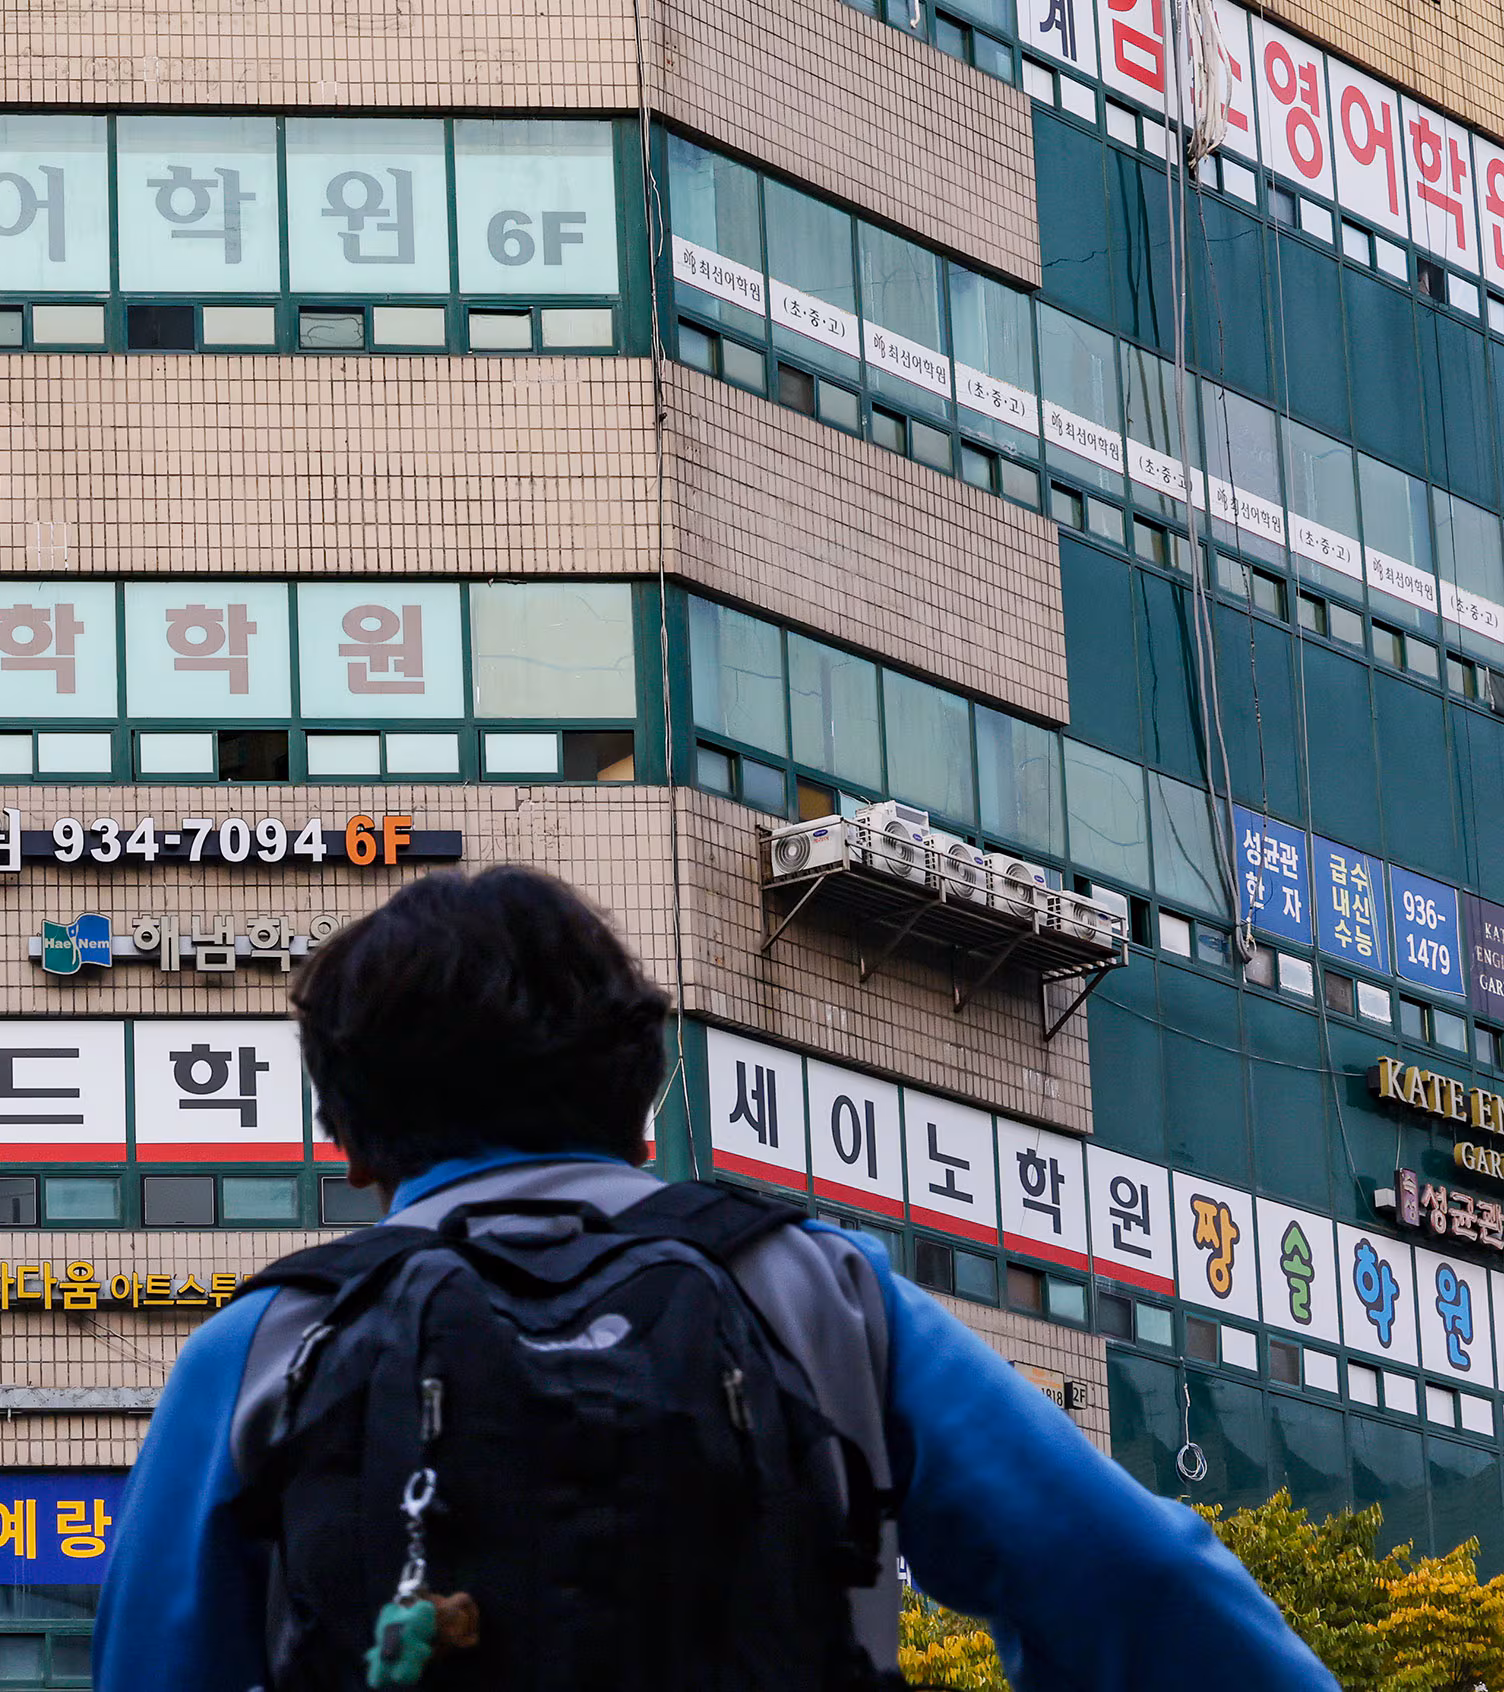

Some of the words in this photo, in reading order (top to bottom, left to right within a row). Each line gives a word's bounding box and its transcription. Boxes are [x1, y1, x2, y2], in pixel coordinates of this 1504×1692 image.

[487, 210, 587, 265] 6F
[699, 259, 761, 302] 최선어학원
[888, 342, 947, 385] 최선어학원
[1065, 420, 1120, 461] 최선어학원
[1229, 493, 1282, 534] 최선어학원
[1386, 567, 1434, 601] 최선어학원
[52, 817, 327, 863] 934-7094
[345, 815, 413, 866] 6F
[1243, 829, 1299, 880] 성균관
[1330, 854, 1368, 892] 급수
[1332, 886, 1371, 925] 내신
[1403, 890, 1446, 930] 936-
[1334, 919, 1373, 957] 수능
[1406, 934, 1451, 976] 1479
[1377, 1056, 1467, 1122] KATE
[729, 1060, 1153, 1260] 세이노학원
[1454, 1142, 1504, 1180] GAR
[110, 1271, 253, 1308] 아트스튜
[1190, 1192, 1474, 1372] 짱솔학원
[1073, 1387, 1085, 1403] 2F
